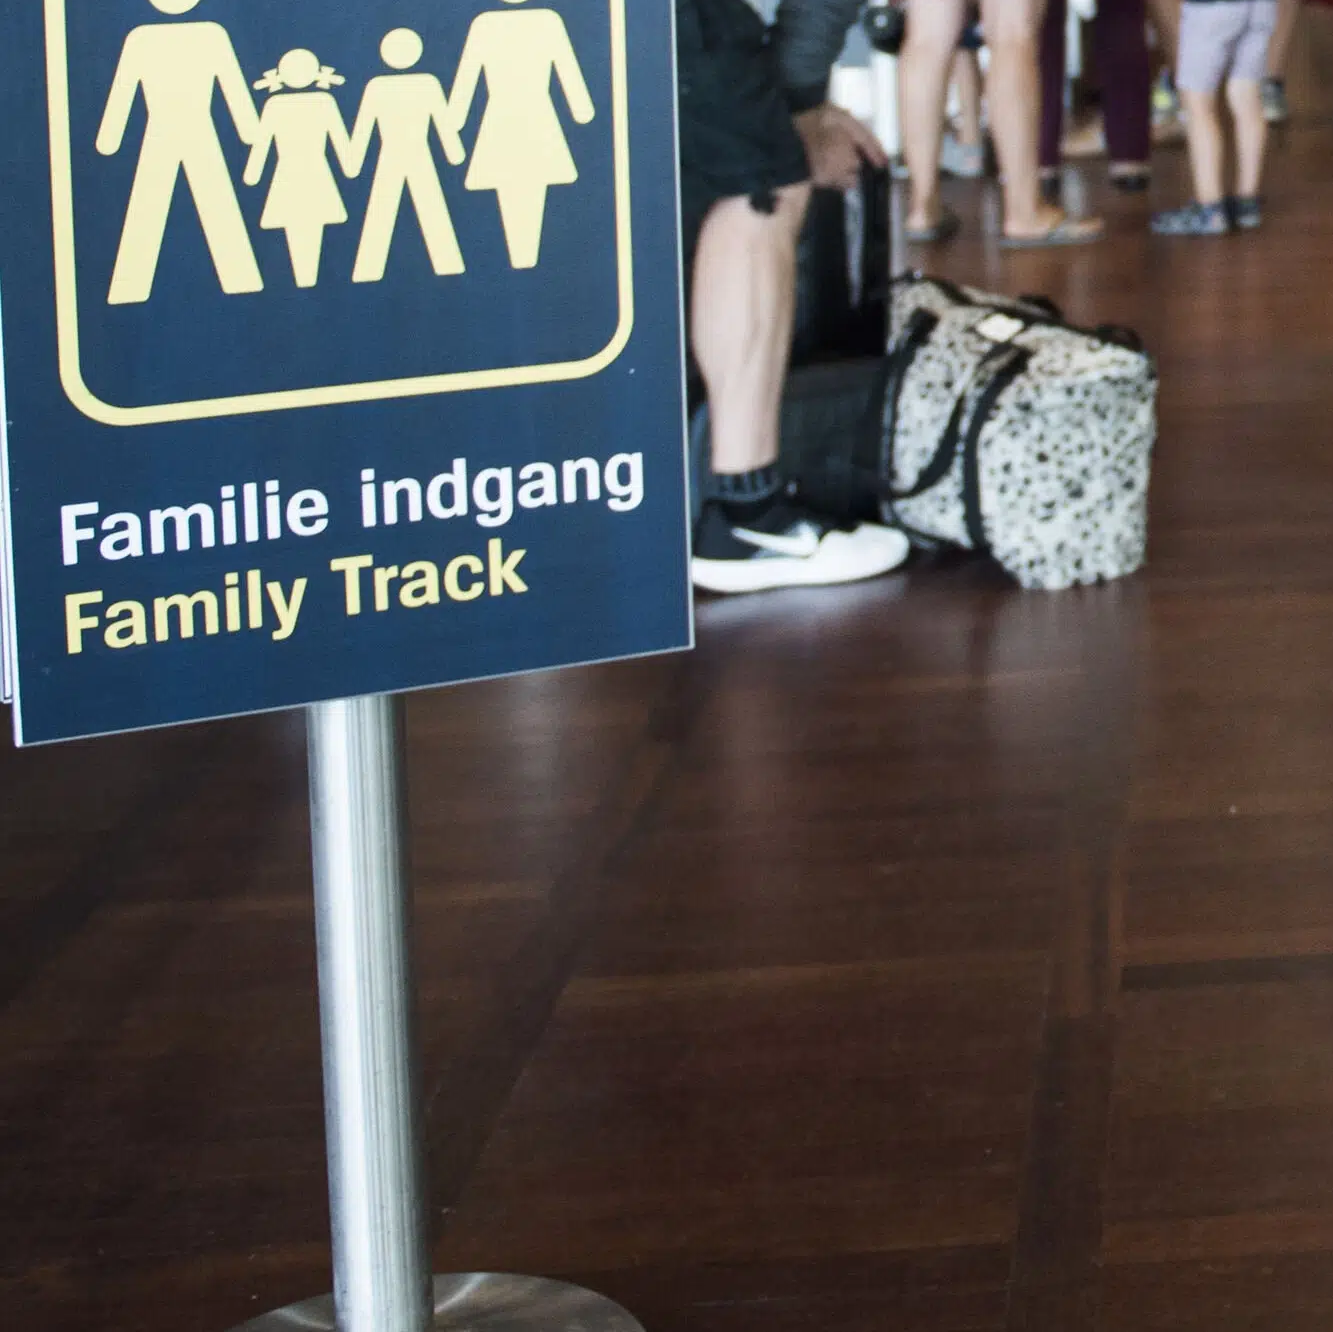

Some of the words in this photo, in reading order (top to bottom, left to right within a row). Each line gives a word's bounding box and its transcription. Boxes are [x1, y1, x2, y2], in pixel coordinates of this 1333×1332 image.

[60, 479, 329, 565] Familie
[360, 451, 645, 528] indgang
[65, 569, 308, 655] Family
[330, 538, 529, 616] Track
